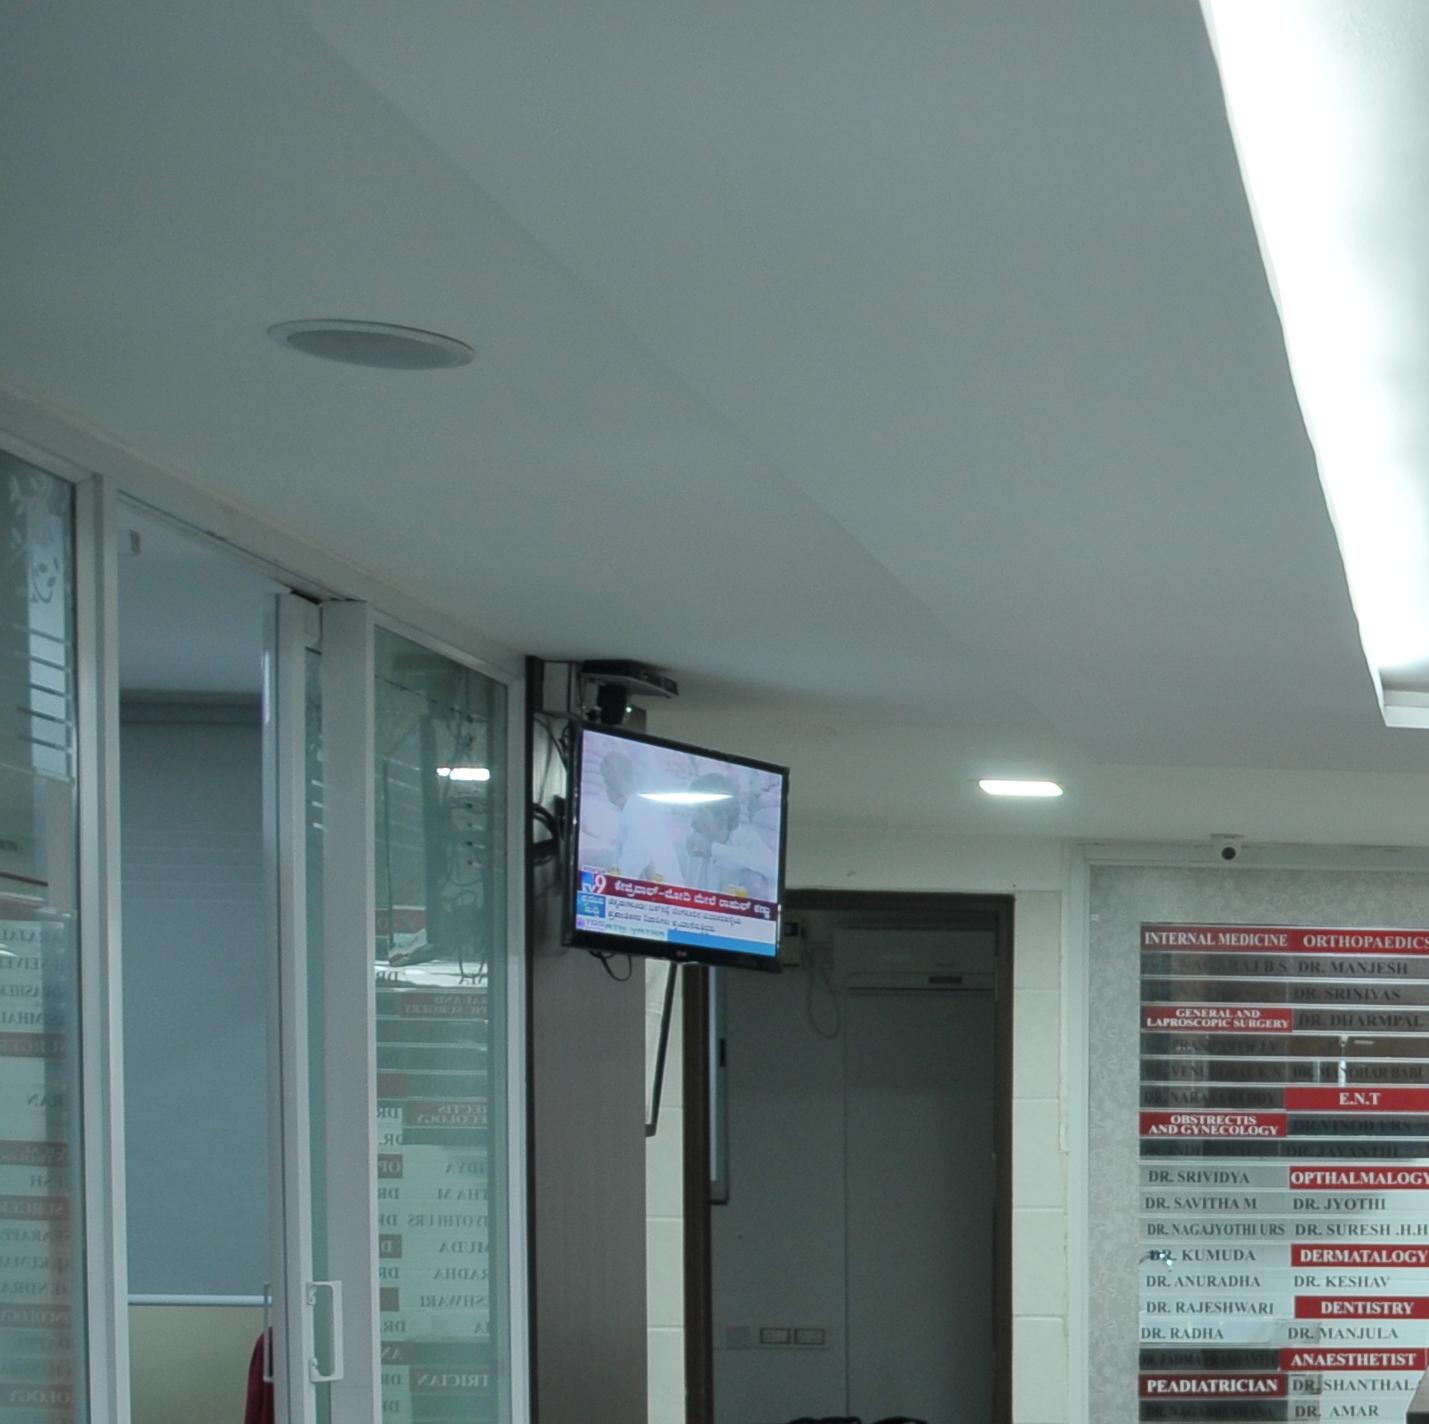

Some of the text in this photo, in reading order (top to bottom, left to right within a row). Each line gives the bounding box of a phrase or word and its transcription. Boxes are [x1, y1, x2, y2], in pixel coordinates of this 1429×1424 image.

[1145, 931, 1288, 947] INTERNAL MEDICINE
[1299, 960, 1408, 974] DR. MANJESH
[1325, 987, 1401, 1001] SRINIVAS
[1175, 1008, 1260, 1018] GENERAL AND
[1146, 1017, 1290, 1029] LAPROSCOPIC SURGERY
[1339, 1092, 1381, 1105] E.N.T
[1170, 1115, 1257, 1125] OBSTRECTIS
[1149, 1125, 1279, 1136] AND GYNECOLOGY
[1149, 1170, 1250, 1184] DR. SRIVIDYA
[1145, 1197, 1257, 1210] DR. SAVITHA M
[1293, 1198, 1386, 1211] DR. JYOTHI
[1147, 1223, 1286, 1237] DR. NAGAJYOTHI URS
[1295, 1223, 1322, 1237] DR.
[1326, 1223, 1391, 1237] SURESH
[1181, 1249, 1256, 1262] KUMUDA
[1300, 1249, 1429, 1264] DERMATALOGY
[1146, 1275, 1261, 1288] DR. ANURADHA
[1294, 1275, 1391, 1288] DR. KESHAV
[1146, 1301, 1275, 1315] DR. RAJESHWARI
[1320, 1301, 1415, 1315] DENTISTRY
[1140, 1327, 1225, 1340] DR. RADHA
[1287, 1327, 1399, 1341] DR. MANJULA
[1290, 1353, 1417, 1367] ANAESTHETIST
[1146, 1379, 1278, 1393] PEADIATRICIAN
[1292, 1378, 1321, 1392] DR.
[1294, 1404, 1379, 1417] DR. AMAR
